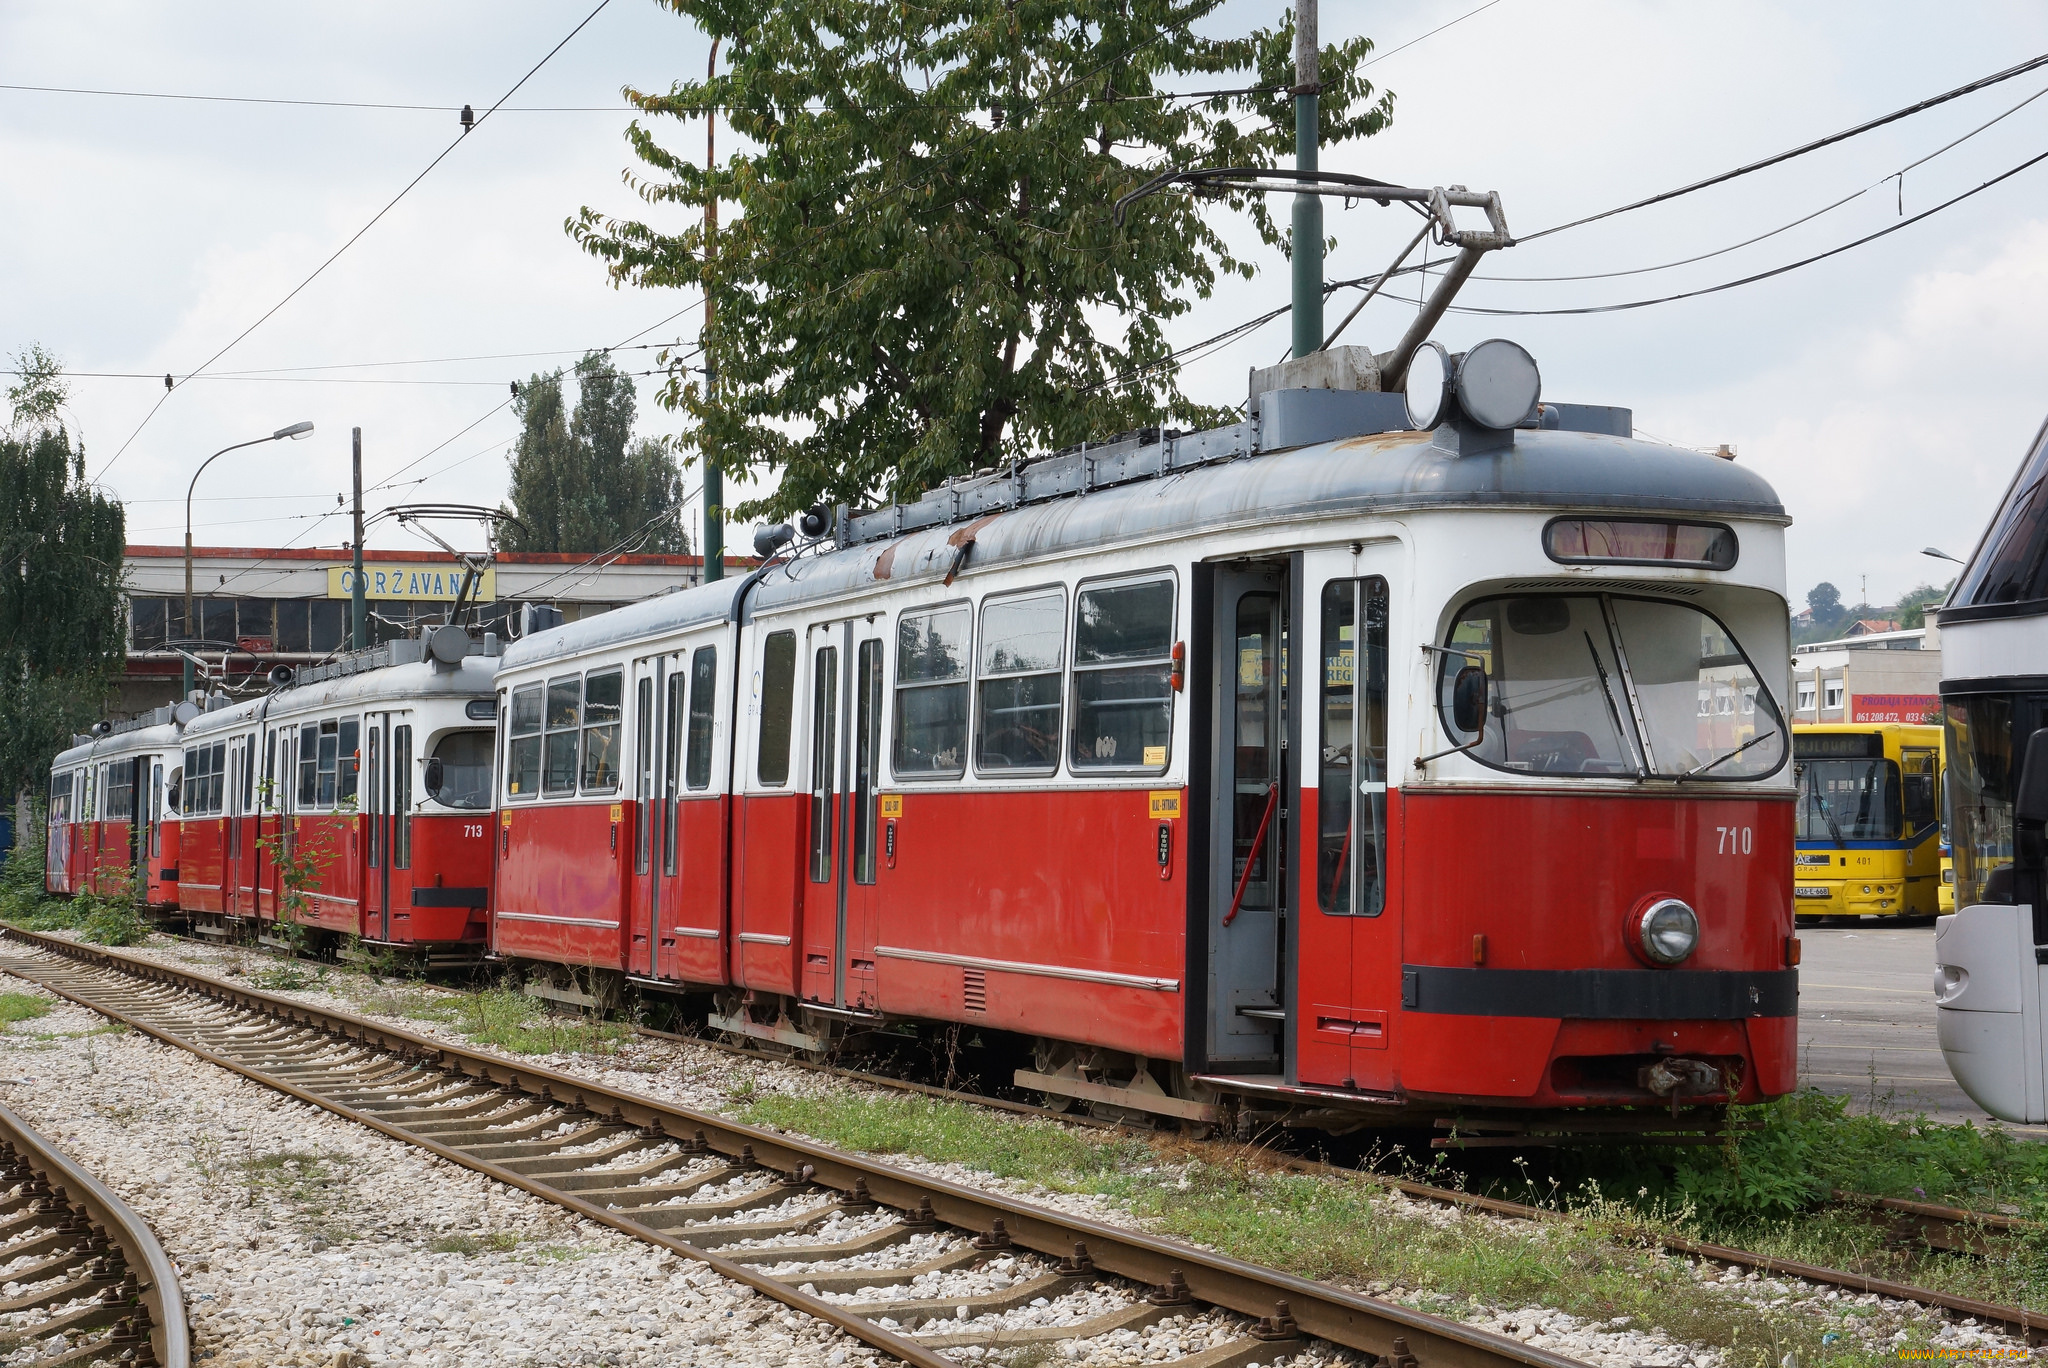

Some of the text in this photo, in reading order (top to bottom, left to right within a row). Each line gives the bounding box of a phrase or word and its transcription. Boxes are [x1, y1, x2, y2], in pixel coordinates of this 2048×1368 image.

[1856, 712, 1869, 722] 061
[1870, 712, 1884, 722] 208
[1905, 712, 1919, 722] 033
[464, 824, 483, 838] 713
[1716, 826, 1752, 855] 710
[1856, 857, 1872, 865] 401
